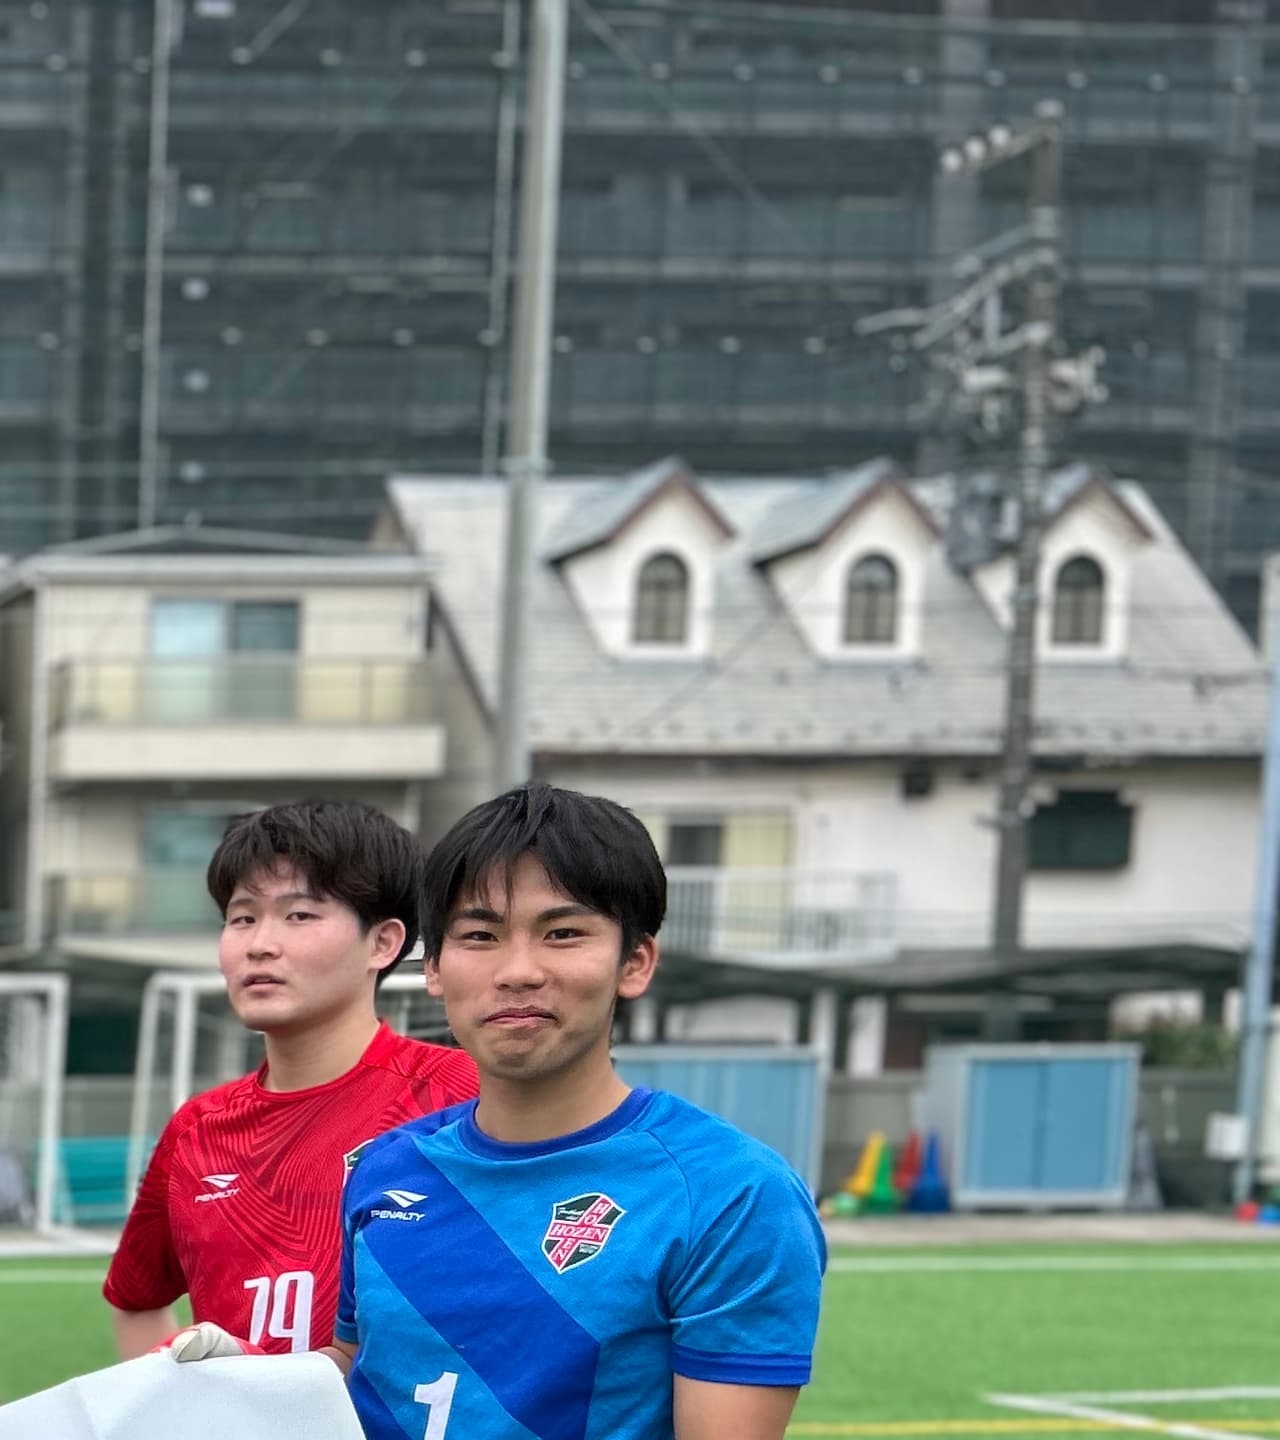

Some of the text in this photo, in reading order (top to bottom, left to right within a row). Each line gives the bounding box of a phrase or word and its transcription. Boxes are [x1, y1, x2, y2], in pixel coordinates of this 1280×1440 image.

[194, 1187, 240, 1204] PENALTY
[370, 1210, 426, 1222] PENALTY
[548, 1224, 609, 1241] HOZEN
